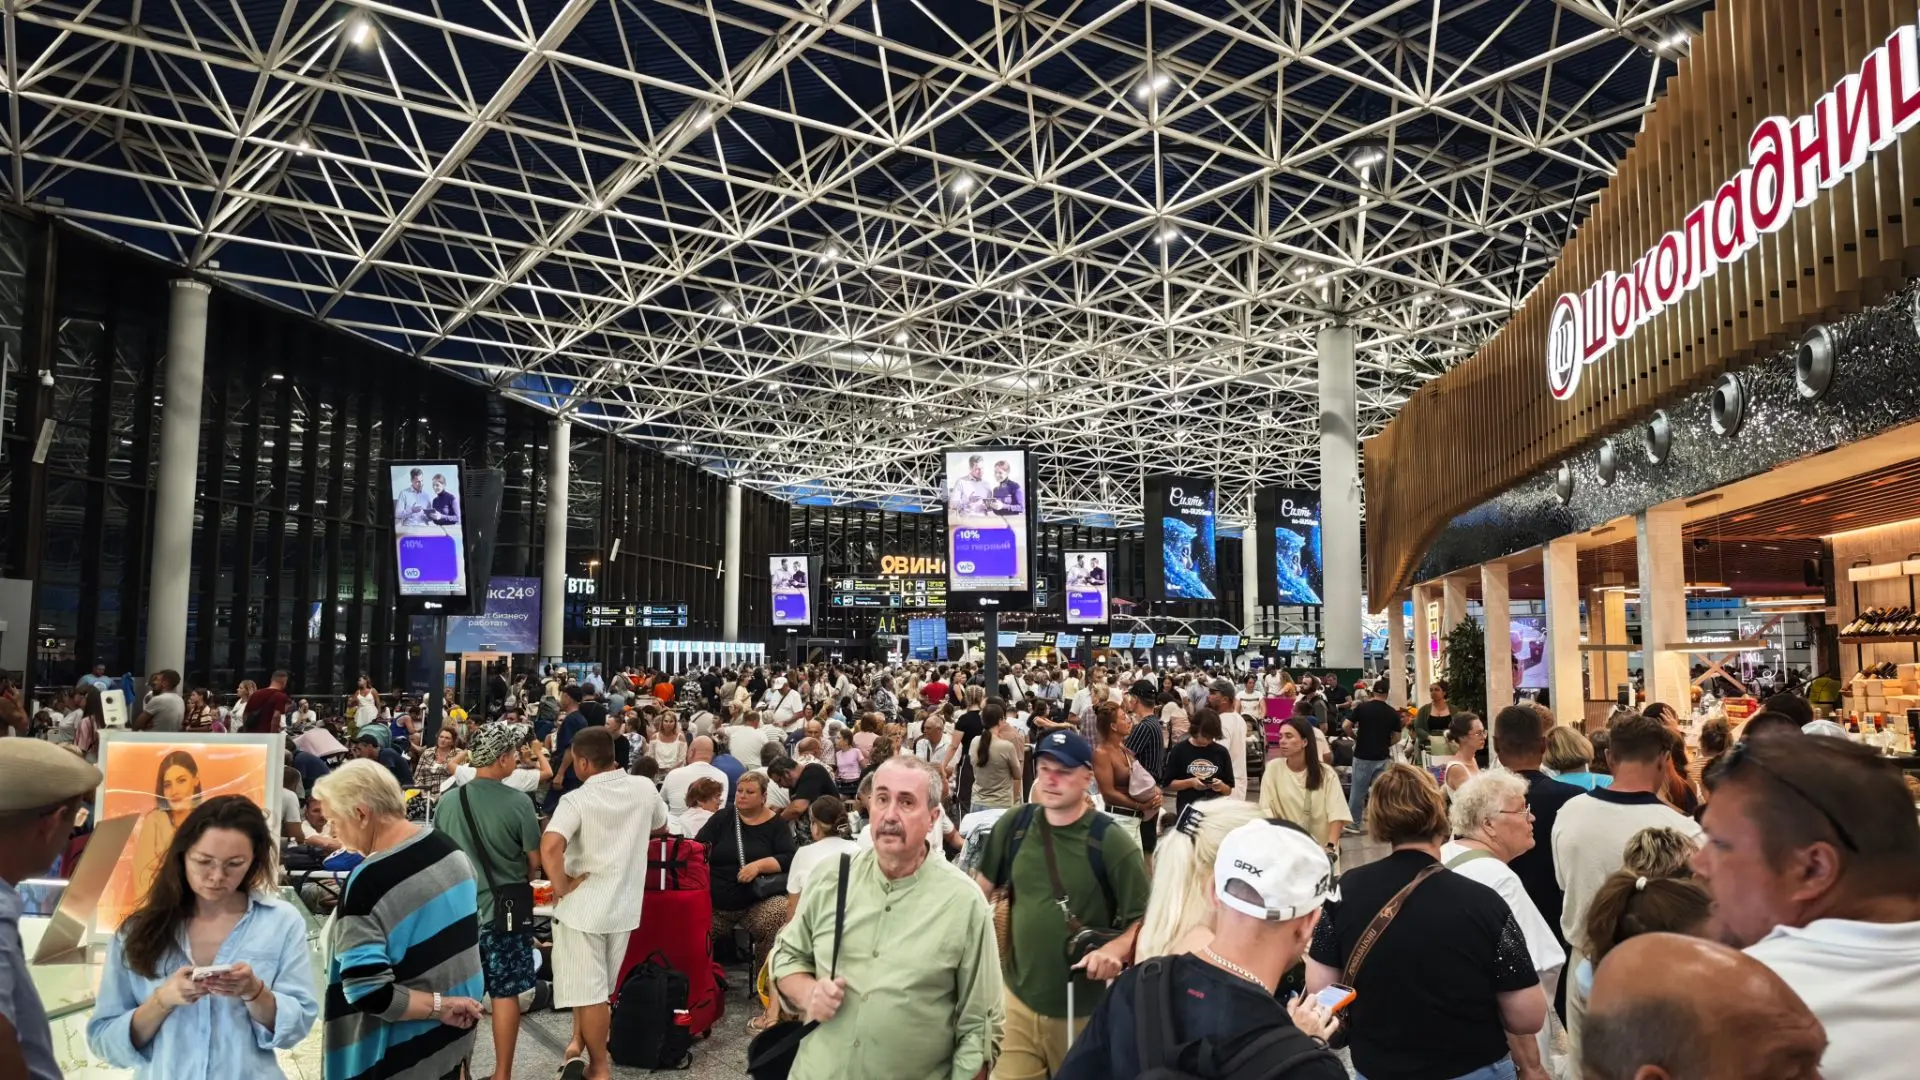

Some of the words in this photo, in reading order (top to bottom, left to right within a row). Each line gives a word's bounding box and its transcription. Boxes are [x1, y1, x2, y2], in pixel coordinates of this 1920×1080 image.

[568, 578, 595, 594] ВТБ
[493, 612, 529, 621] бизнесу
[468, 620, 508, 628] работать
[1156, 636, 1164, 644] 14
[1234, 859, 1263, 878] GRX
